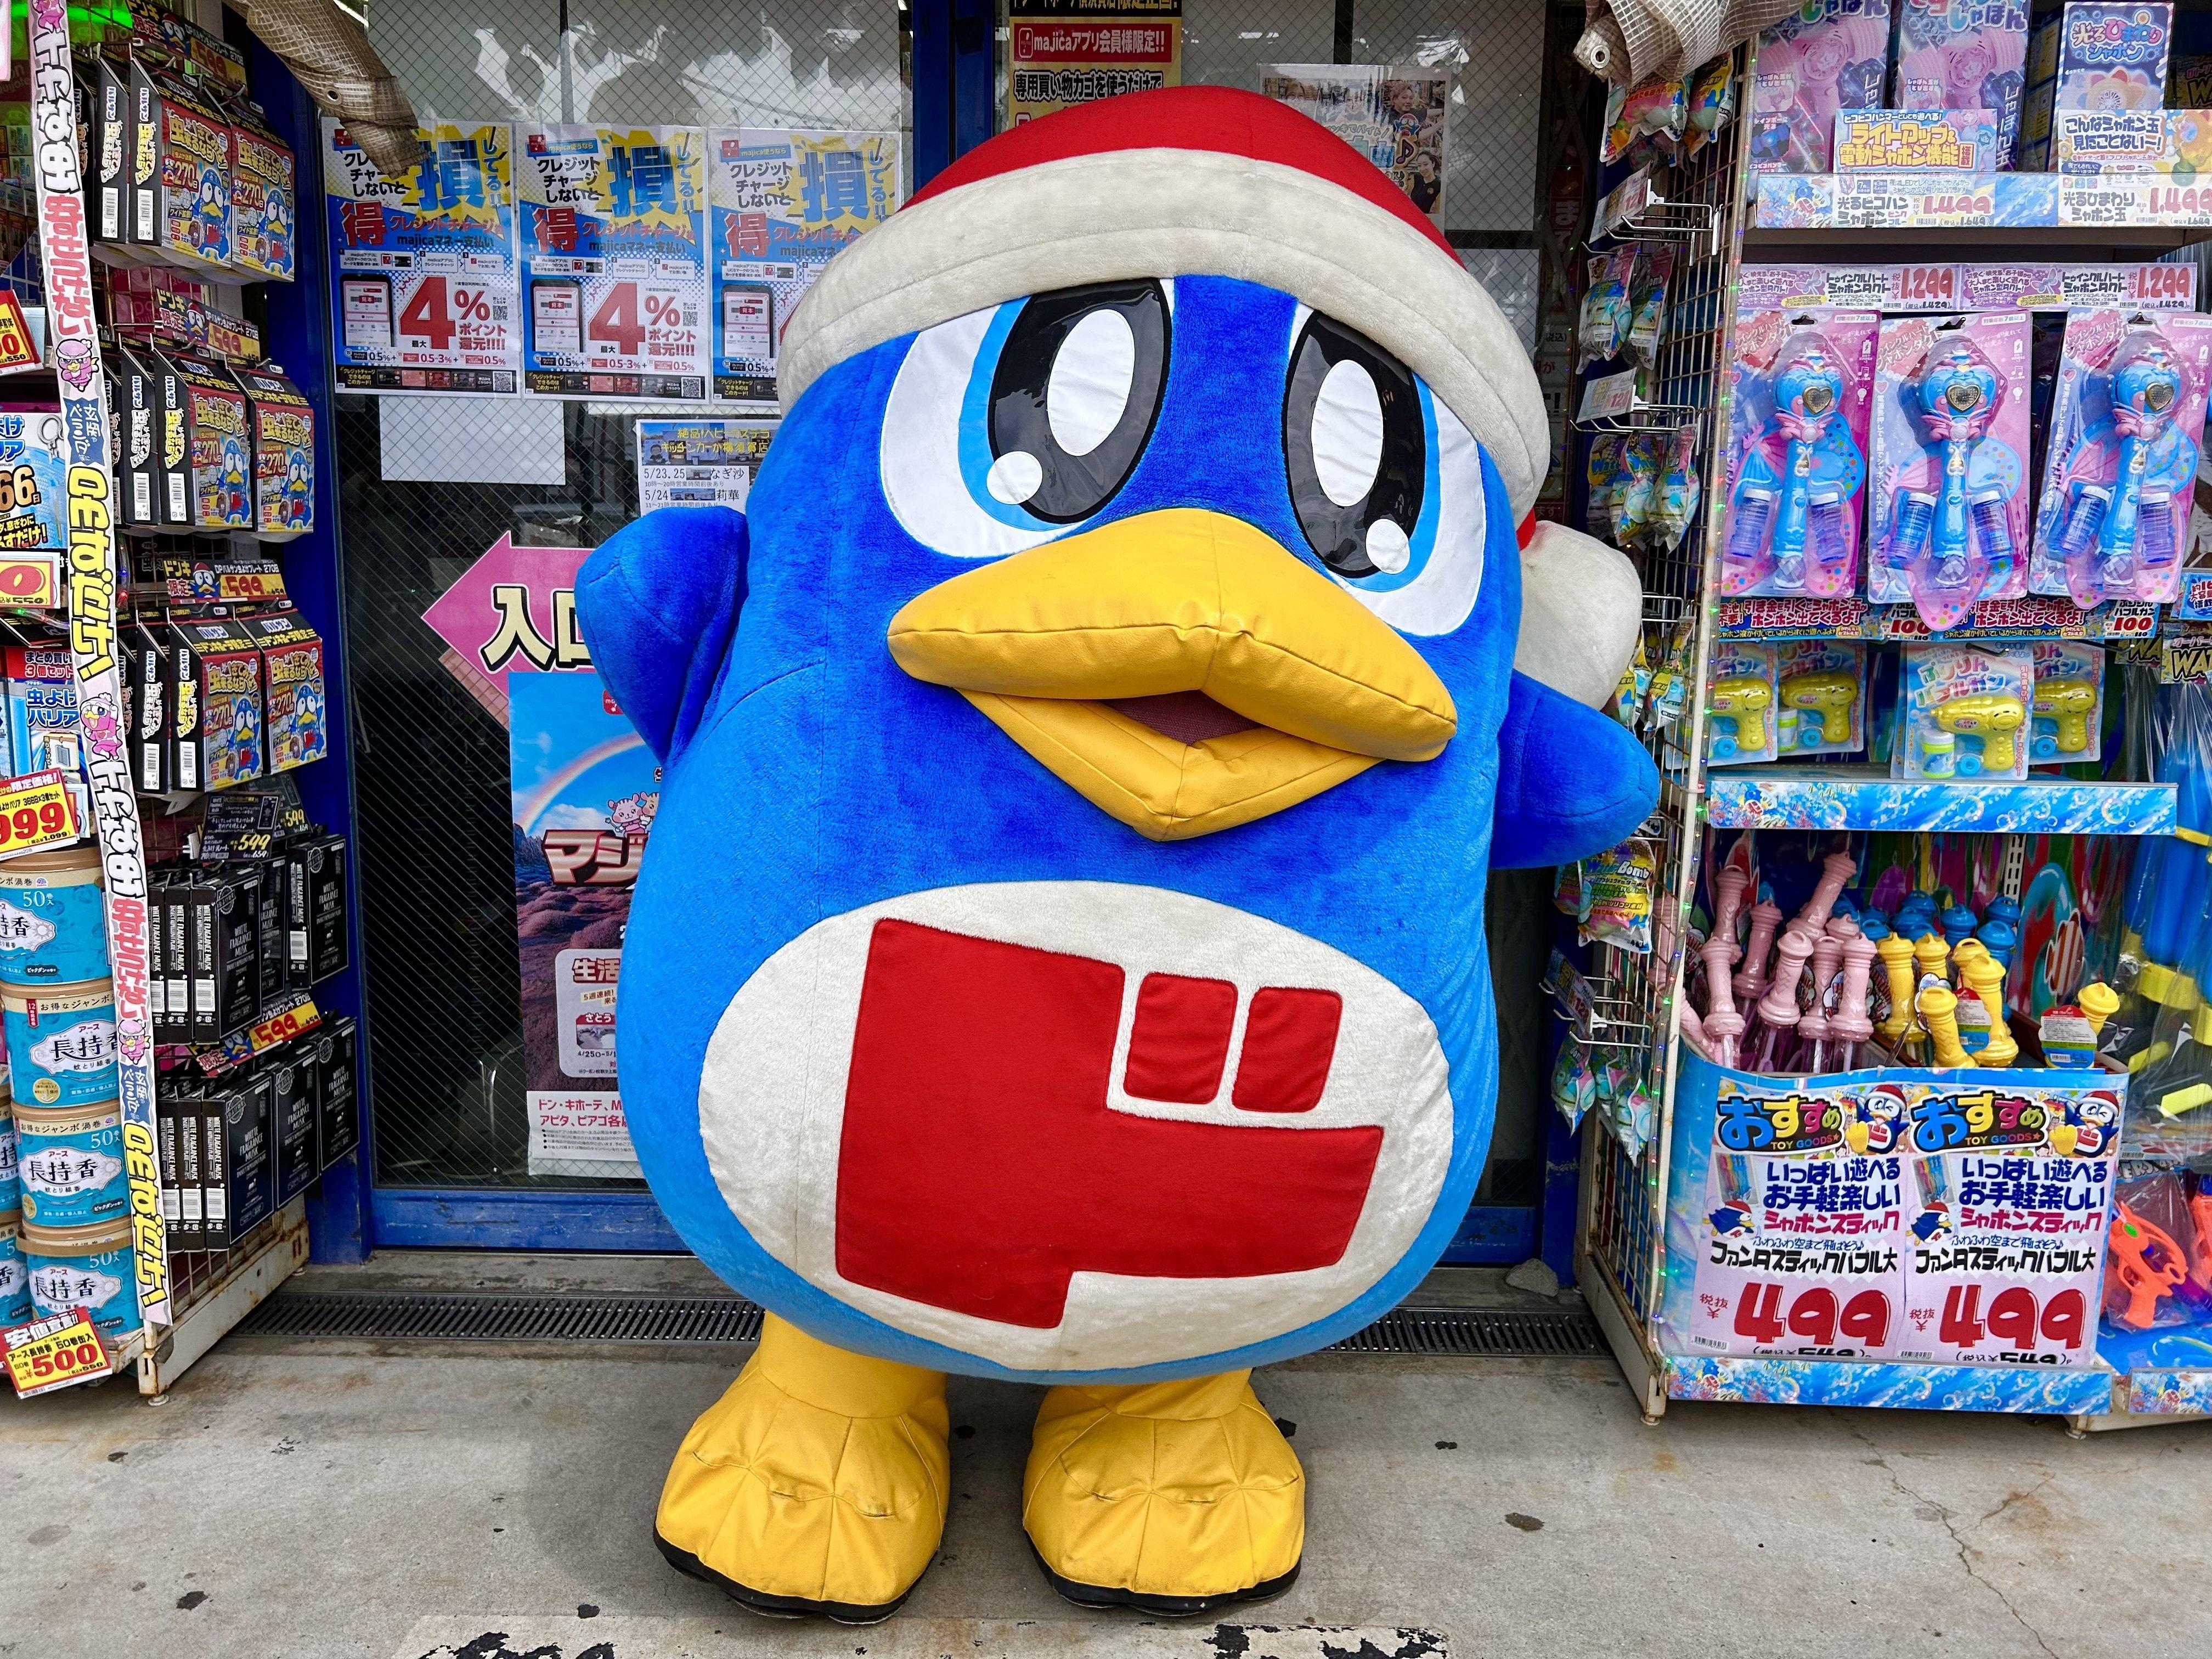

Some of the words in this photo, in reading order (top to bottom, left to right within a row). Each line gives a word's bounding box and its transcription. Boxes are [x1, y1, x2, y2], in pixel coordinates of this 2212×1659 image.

[1948, 4, 2028, 32] しゃぼん
[2072, 18, 2163, 46] 光るひまわり
[1034, 30, 1165, 54] majicaアプリ会員様限定!!
[2086, 43, 2143, 60] シャボン
[1014, 69, 1164, 102] 専用買い物カゴを使うだけで
[33, 29, 81, 194] イヤな虫
[1997, 85, 2020, 167] しゃぼん玉
[2065, 116, 2160, 134] こんなシャボン玉
[537, 156, 601, 173] クレジット
[1960, 145, 1971, 167] 搭載
[416, 139, 486, 211] 損
[544, 171, 598, 188] チャージ
[730, 162, 793, 179] クレジット
[353, 182, 406, 196] しないと
[606, 145, 679, 217] 損
[736, 176, 789, 193] チャージ
[798, 150, 870, 223] 損
[545, 188, 600, 203] しないと
[738, 193, 792, 208] しないと
[1837, 196, 1909, 211] 光るピコハン
[2063, 191, 2135, 207] 光るひまわり
[340, 200, 387, 246] 得
[2072, 207, 2127, 222] シャボン玉
[532, 206, 579, 252] 得
[724, 211, 771, 258] 得
[44, 194, 97, 337] 寄せつけない
[1826, 273, 1889, 284] トゥインクルハート
[1900, 267, 1954, 300] 1,299
[2062, 272, 2125, 282] トゥインクルハート
[2138, 266, 2191, 299] 1,299
[156, 288, 186, 313] ドンキ
[159, 307, 184, 332] 限定
[398, 275, 490, 349] 4%
[588, 281, 680, 355] 4%
[458, 323, 507, 337] ポイント
[648, 330, 696, 343] ポイント
[458, 337, 505, 351] 還元!!!!
[601, 346, 616, 354] 最大
[648, 343, 696, 356] 還元!!!!
[484, 355, 506, 365] 0.5%
[673, 361, 695, 371] 0.5%
[747, 363, 769, 373] 0.5%
[644, 467, 685, 479] 5/23.25
[710, 468, 744, 480] なぎ沙
[645, 489, 669, 501] 5/24
[716, 490, 740, 501] 莉華
[163, 560, 191, 577] ドンキ
[263, 563, 280, 573] 270日
[166, 578, 191, 597] 限定
[225, 575, 264, 596] 599
[1752, 611, 1860, 628] ポンポン出てくるよ!
[1974, 610, 2084, 627] ポンポン出てくるよ!
[2114, 608, 2155, 617] バブルガン
[2113, 617, 2152, 631] 100
[25, 651, 72, 664] まとめ買い
[25, 664, 74, 679] 3個セット
[26, 687, 77, 707] 虫よけ
[27, 708, 80, 728] バリア
[43, 736, 52, 766] 吊り下げて
[285, 809, 305, 827] 599
[89, 760, 146, 899] イヤな虫
[238, 834, 272, 851] 599
[1617, 860, 1650, 880] Bomb
[22, 890, 54, 907] 50巻入
[109, 898, 150, 1022] 寄せつけない
[295, 994, 312, 1007] 270日
[583, 989, 614, 1001] 5週連続!
[585, 1012, 612, 1023] さとう
[78, 1024, 100, 1033] アース
[255, 1013, 300, 1043] 599
[74, 1059, 111, 1070] 蚊とり線香
[198, 1049, 226, 1071] 限定
[20, 1120, 101, 1133] お得なジャンボ渦巻
[1718, 1094, 1842, 1151] おすすめ
[1913, 1094, 2045, 1150] おすすめ
[91, 1130, 121, 1149] 50巻入
[1771, 1141, 1794, 1150] TOY
[1796, 1133, 1835, 1148] GOODS
[1965, 1134, 1987, 1147] TOY
[1990, 1132, 2032, 1145] GOODS
[29, 1158, 99, 1182] 長持香
[1767, 1157, 1901, 1181] いっぱい遊べる
[1962, 1158, 2108, 1182] いっぱい遊べる
[44, 1186, 81, 1194] 蚊とり線香
[1763, 1183, 1901, 1211] お手軽楽しい
[1958, 1182, 2106, 1211] お手軽楽しい
[1764, 1209, 1899, 1233] シャボンスティック
[1960, 1209, 2102, 1233] シャボンスティック
[1709, 1241, 1897, 1276] ファンタスティックバブル大
[1915, 1240, 2096, 1274] ファンタスティックバブル大
[35, 1276, 97, 1299] 長持香
[1699, 1293, 1729, 1308] 税抜
[1734, 1281, 1892, 1347] 499
[1908, 1307, 1936, 1321] 税抜
[1939, 1283, 2086, 1349] 499
[8, 1342, 53, 1362] アース長持香
[32, 1344, 98, 1377] 500
